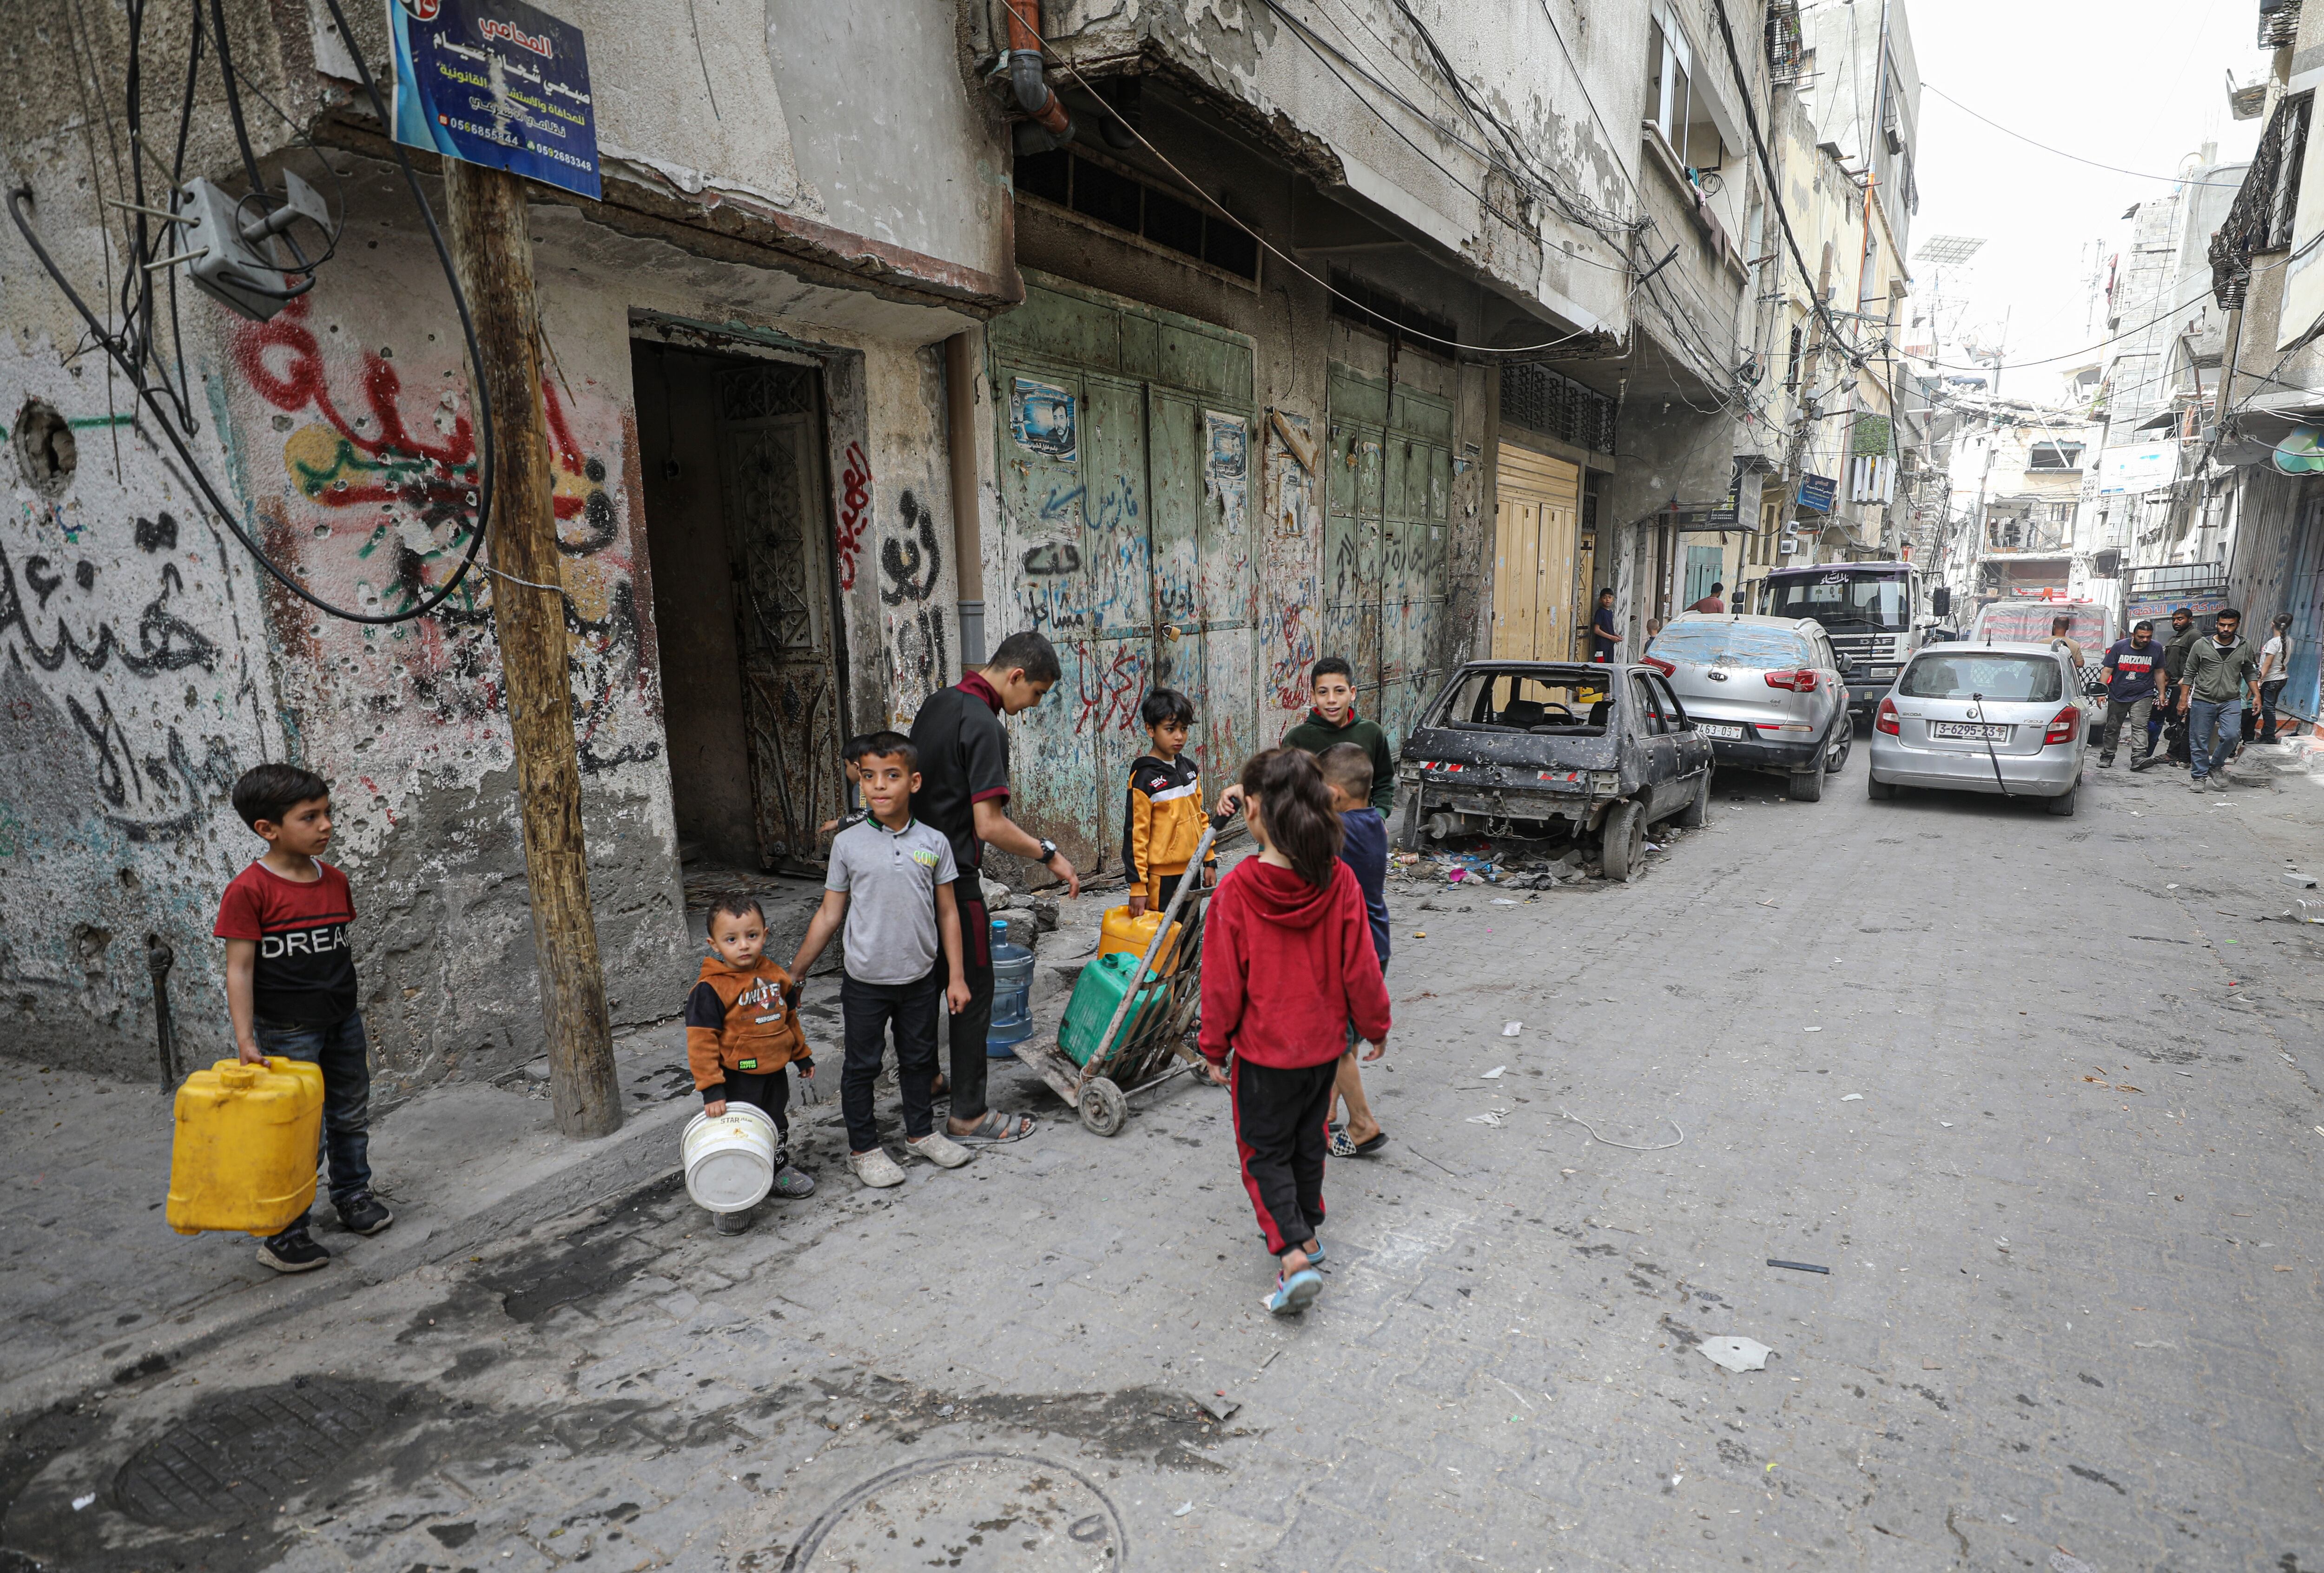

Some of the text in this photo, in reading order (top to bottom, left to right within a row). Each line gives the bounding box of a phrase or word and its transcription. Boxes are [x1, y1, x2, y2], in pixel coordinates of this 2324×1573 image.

[478, 17, 553, 59] المحامي
[440, 63, 488, 88] القانونية
[543, 79, 591, 105] صبحي
[450, 118, 592, 172] 0566855844 0592683348
[2118, 654, 2152, 666] ARIZONA
[1939, 723, 1995, 737] 3-6295-23
